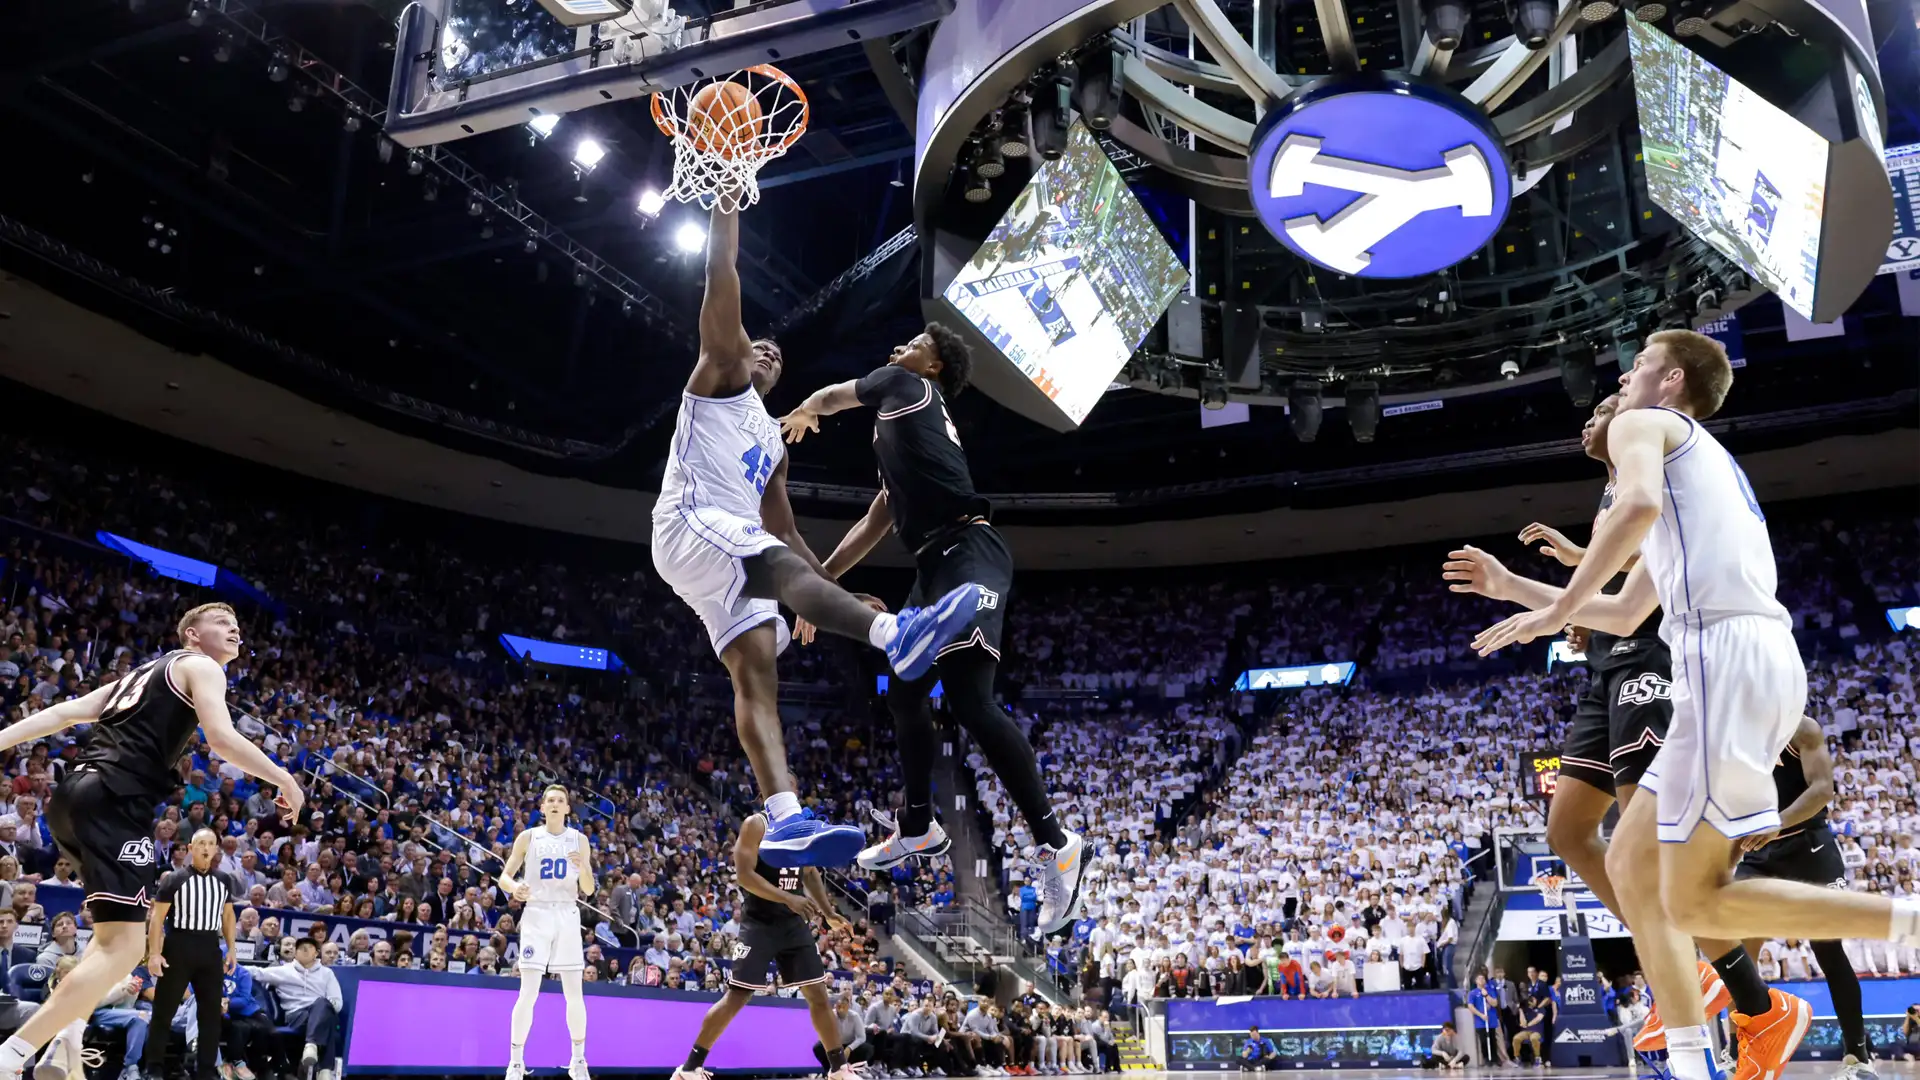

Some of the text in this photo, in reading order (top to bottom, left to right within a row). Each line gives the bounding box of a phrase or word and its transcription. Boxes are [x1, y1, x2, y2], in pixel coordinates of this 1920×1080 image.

[1267, 132, 1494, 275] Y
[1617, 672, 1672, 706] OSU
[1533, 757, 1561, 773] 5:49
[540, 858, 567, 880] 20
[778, 877, 799, 890] STATE
